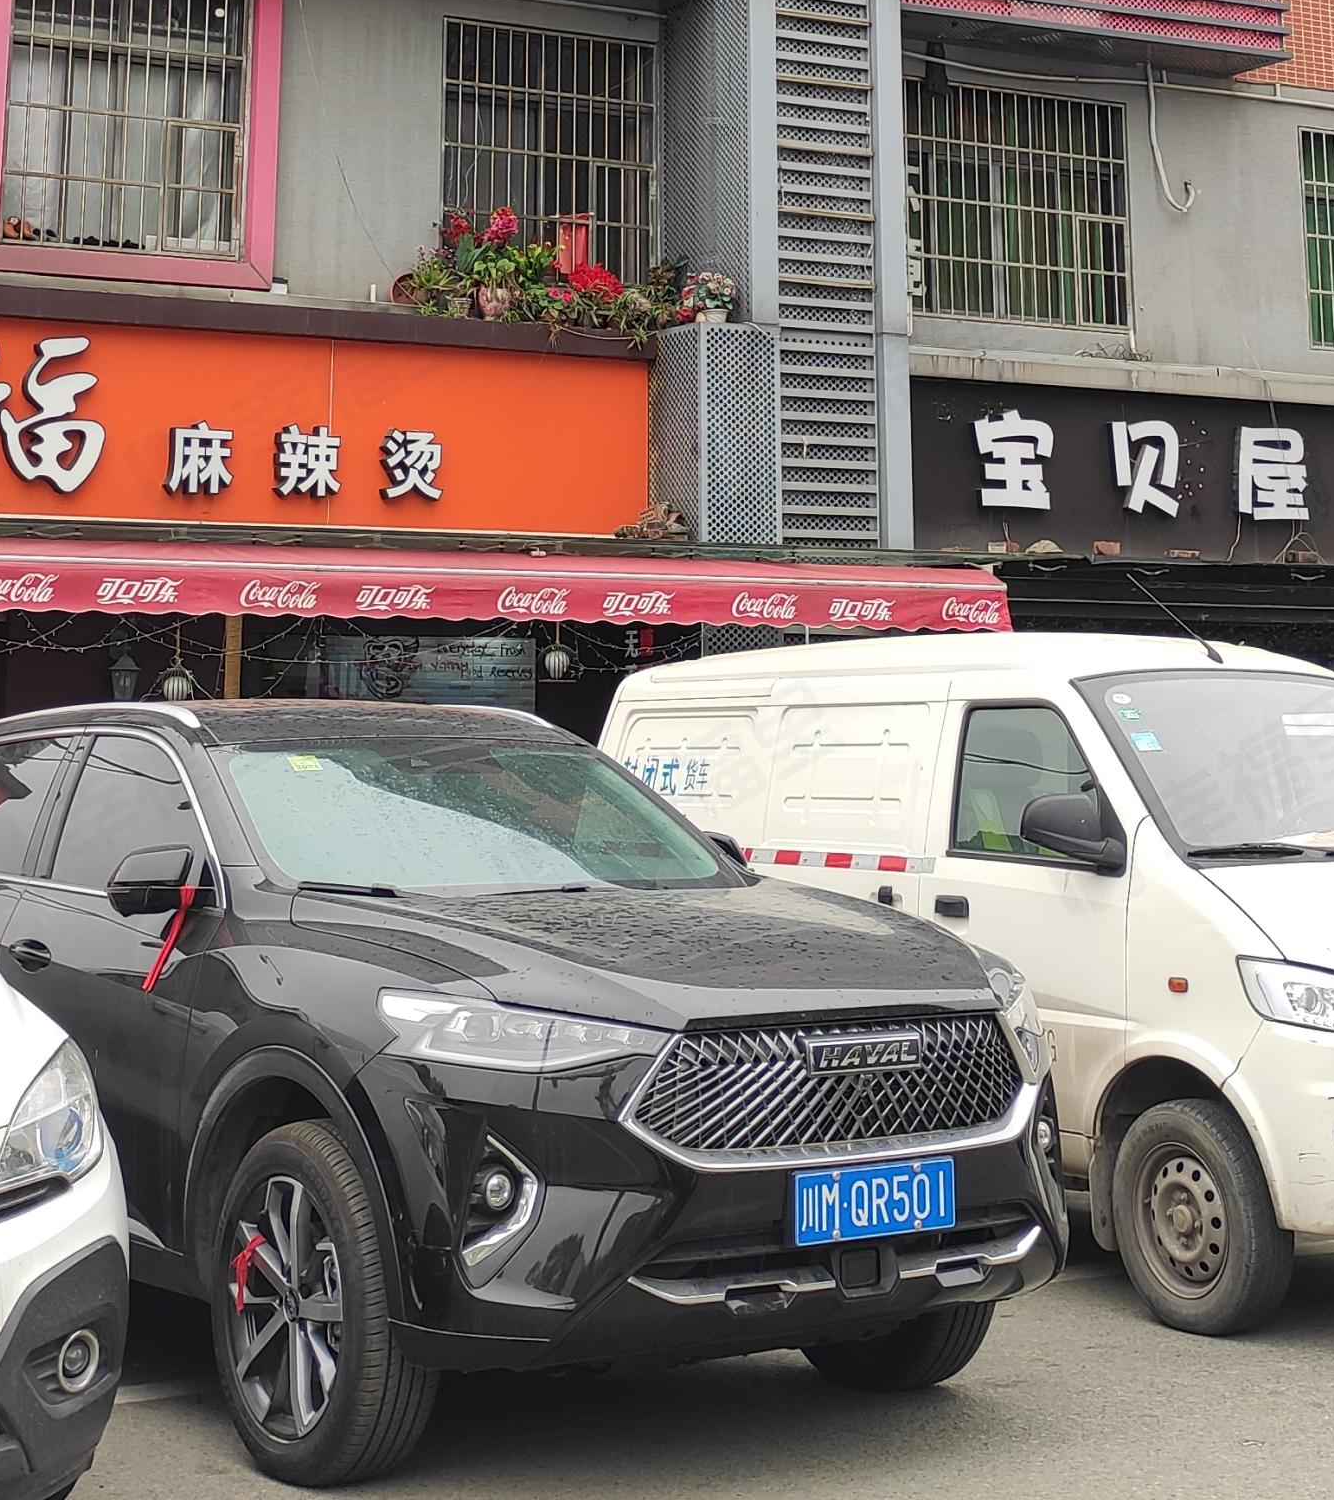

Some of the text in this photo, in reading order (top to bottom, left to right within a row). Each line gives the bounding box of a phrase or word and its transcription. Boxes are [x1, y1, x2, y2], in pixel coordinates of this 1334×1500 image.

[165, 421, 444, 500] 麻辣烫
[974, 409, 1310, 521] 宝贝屋
[96, 576, 186, 605] 可口可乐
[356, 583, 437, 613] 可口可乐
[602, 590, 676, 617] 可口可乐
[829, 597, 897, 622] 可口可乐
[819, 1042, 918, 1069] HAVAL
